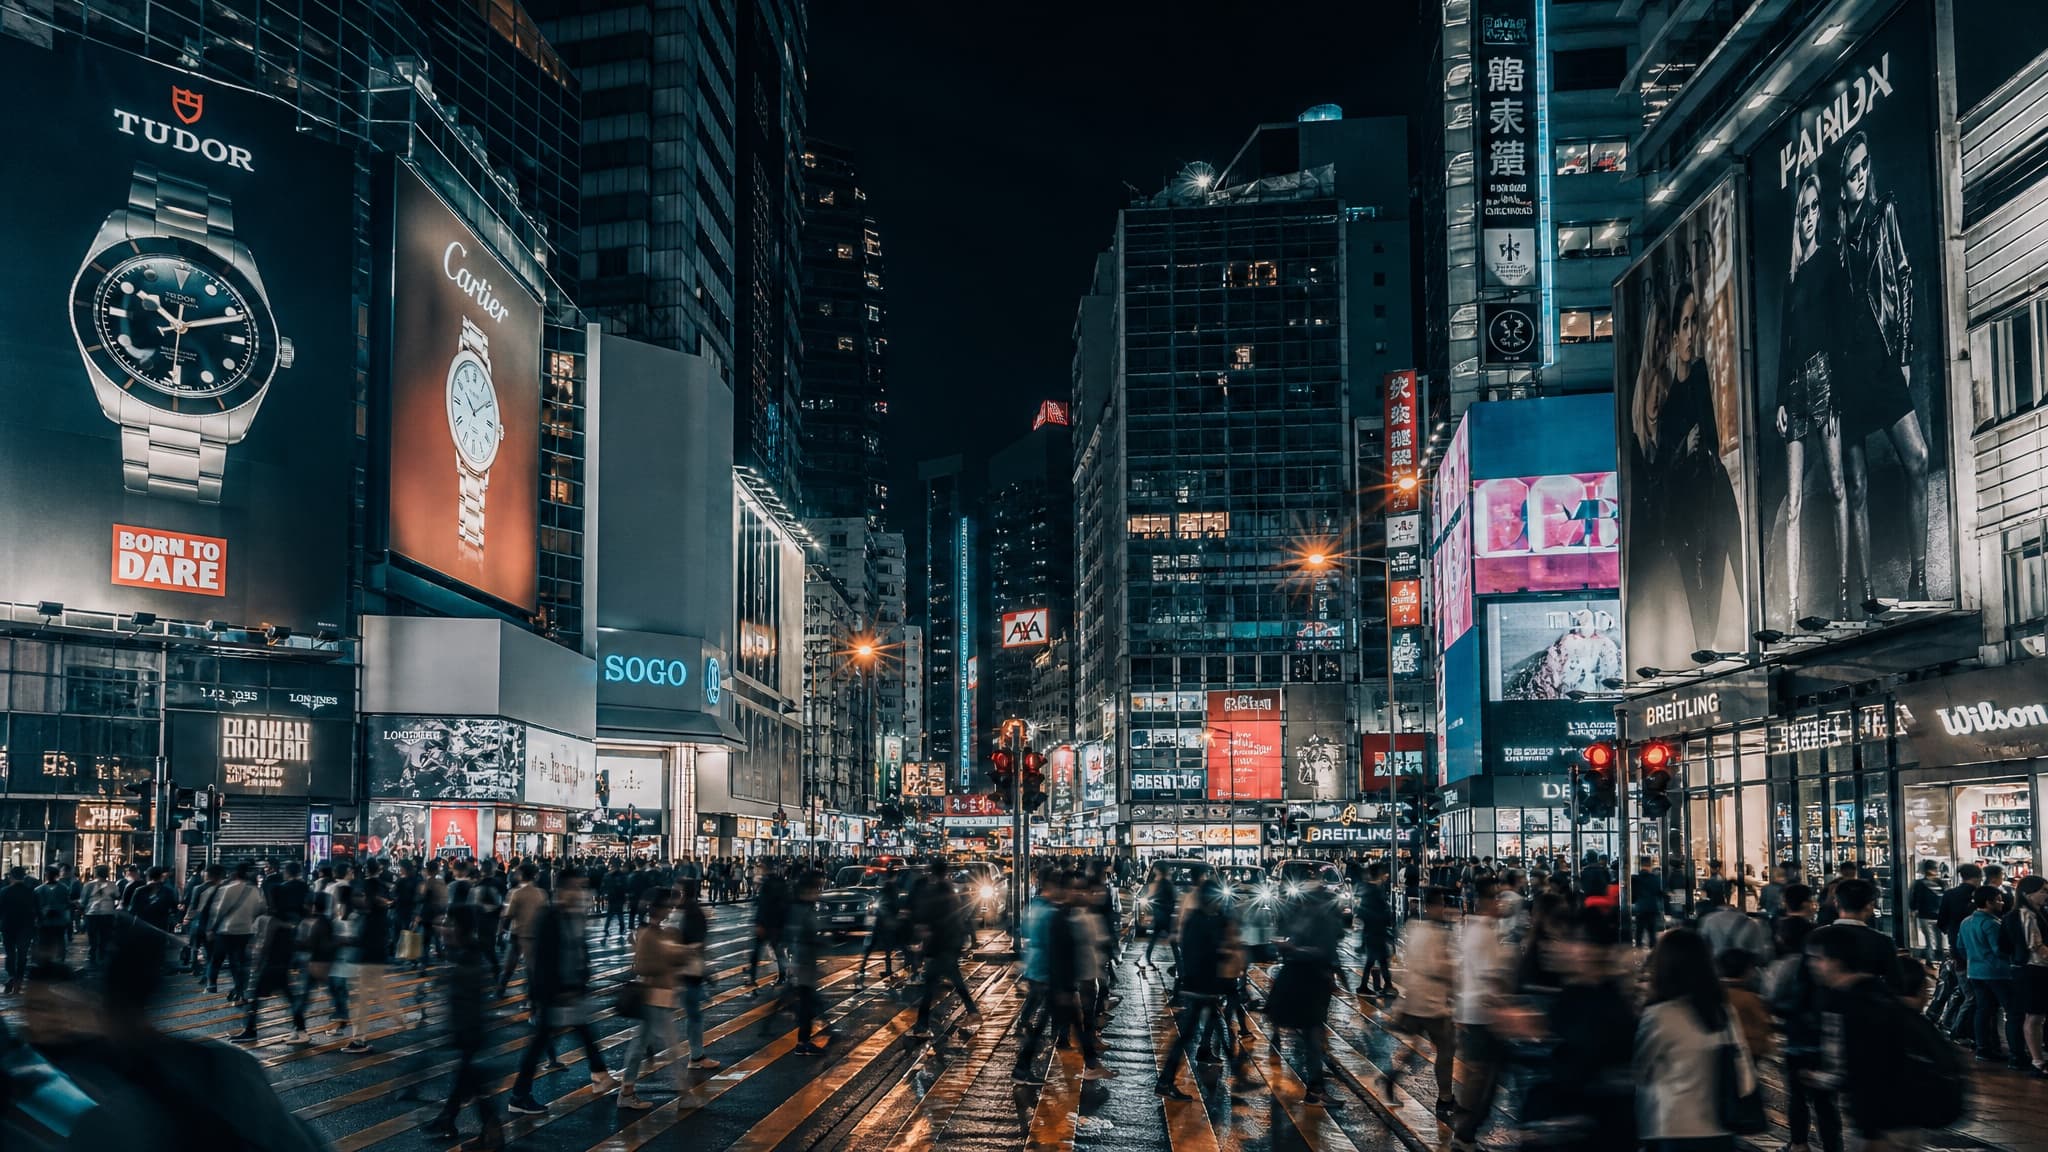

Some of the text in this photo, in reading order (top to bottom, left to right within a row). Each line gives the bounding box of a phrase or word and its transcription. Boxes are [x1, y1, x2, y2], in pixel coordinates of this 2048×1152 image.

[114, 108, 255, 172] TUDOR
[443, 241, 509, 323] Cartier
[119, 531, 220, 561] BORN TO
[118, 550, 219, 589] DARE
[1006, 612, 1043, 642] AXA
[605, 655, 687, 686] SOGO
[1646, 692, 1720, 727] BREITLING
[1936, 701, 2048, 735] Wilson
